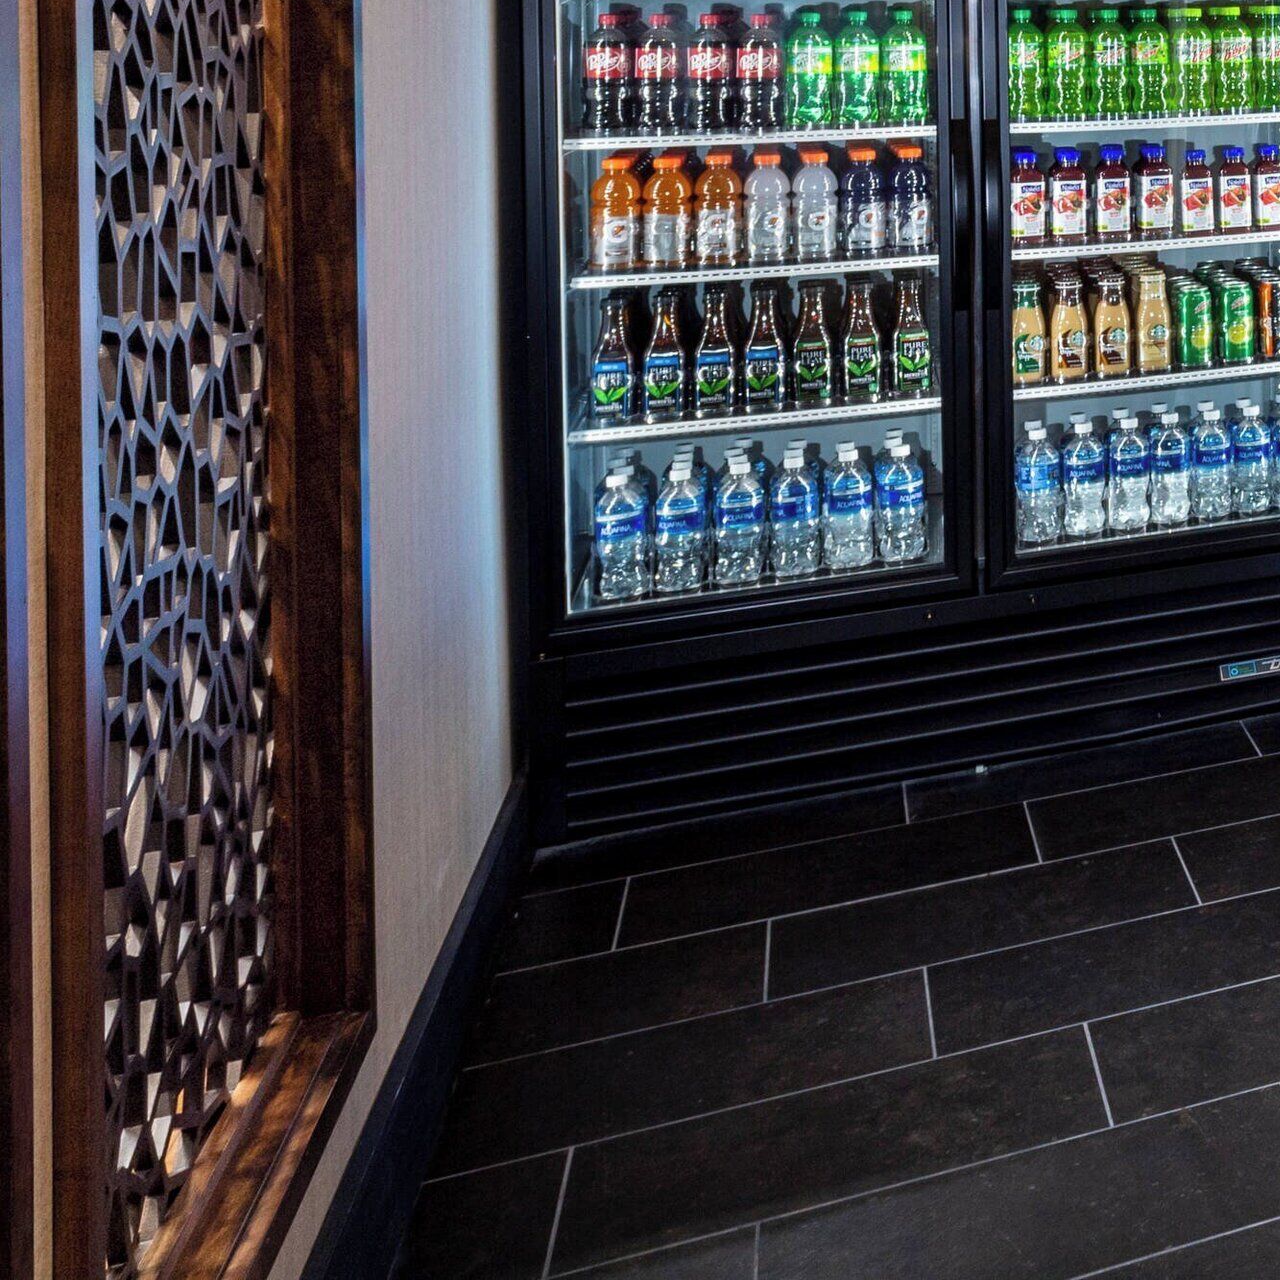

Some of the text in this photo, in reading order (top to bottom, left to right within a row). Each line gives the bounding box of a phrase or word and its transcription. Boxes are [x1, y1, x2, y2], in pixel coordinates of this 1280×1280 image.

[903, 341, 927, 349] PURE
[850, 346, 874, 354] PURE
[801, 351, 825, 359] PURE
[601, 524, 631, 536] AQUAFINA
